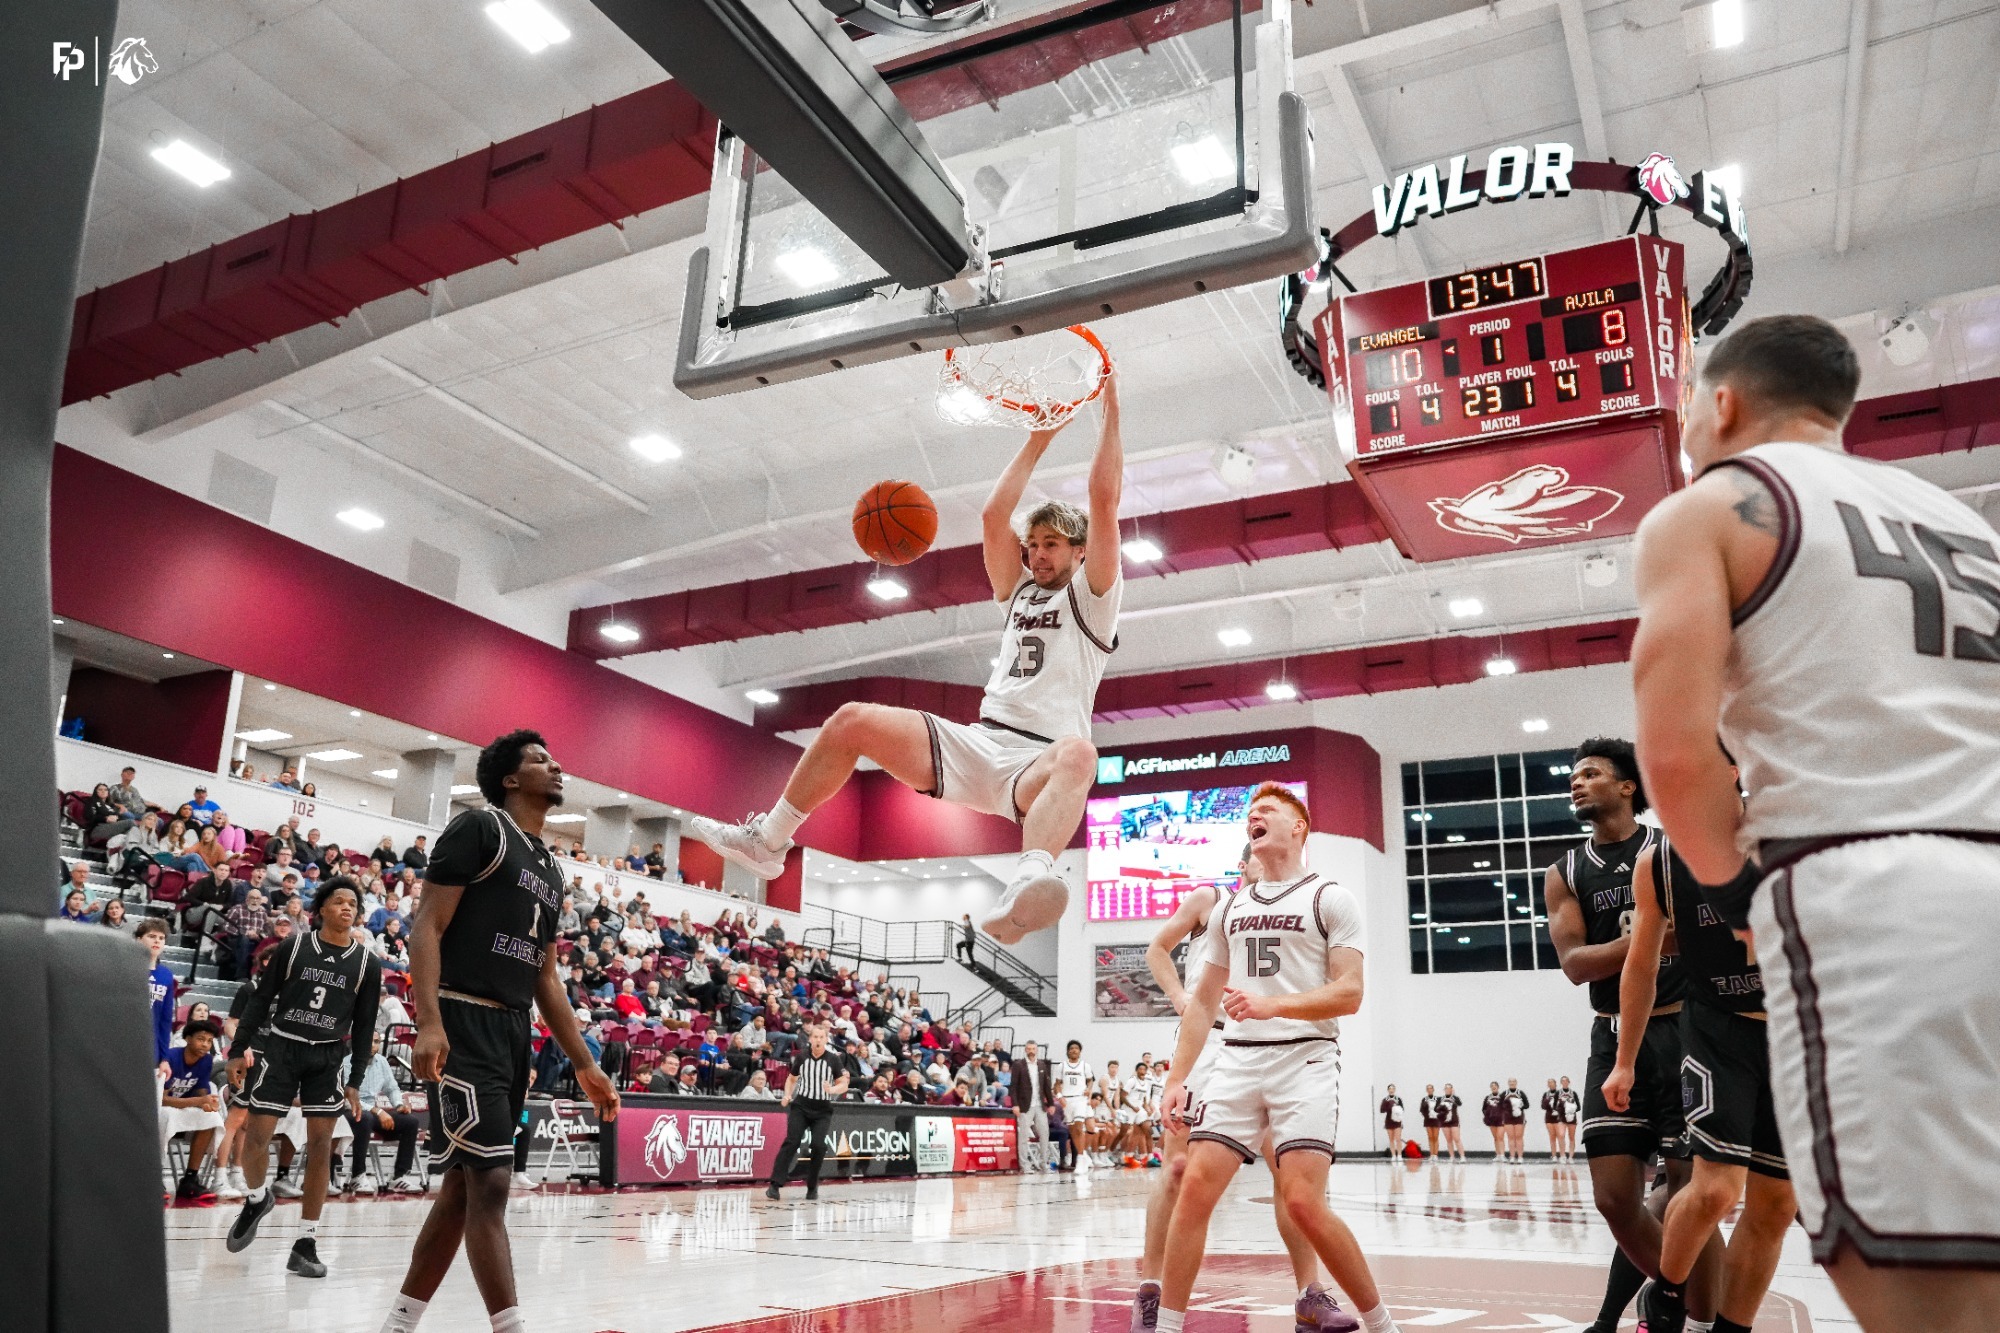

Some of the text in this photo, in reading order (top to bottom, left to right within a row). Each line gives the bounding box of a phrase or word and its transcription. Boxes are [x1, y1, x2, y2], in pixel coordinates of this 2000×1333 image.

[1372, 142, 1574, 234] VALOR
[1446, 261, 1540, 309] 13:47
[1565, 288, 1615, 312] AVILA
[1653, 244, 1676, 379] VALOR
[1470, 318, 1511, 335] PERIOD
[1602, 309, 1626, 346] 8
[1360, 327, 1426, 351] EVANGEL
[1494, 337, 1503, 361] 1
[1321, 310, 1346, 412] VALO
[1390, 347, 1423, 383] 10
[1549, 358, 1580, 373] T.O.L.
[1595, 347, 1634, 364] FOULS
[1459, 364, 1536, 389] PLAYER FOUL
[1557, 373, 1577, 397] 4
[1624, 364, 1632, 388] 1
[1365, 389, 1401, 406] FOULS
[1415, 382, 1444, 397] T.O.L.
[1464, 381, 1533, 417] 23 1
[1422, 397, 1440, 421] 4
[1600, 394, 1641, 412] SCORE
[1390, 405, 1398, 429] 1
[1480, 414, 1521, 432] MATCH
[1369, 434, 1406, 450] SCORE
[1834, 499, 2000, 663] 45
[1124, 744, 1291, 777] AGFinancial ARENA
[292, 800, 315, 818] 102
[517, 868, 559, 912] AVILA
[1593, 884, 1636, 913] AVI
[1229, 915, 1307, 937] EVANGEL
[1245, 937, 1281, 978] 15
[300, 967, 347, 989] AVILA
[309, 986, 327, 1010] 3
[284, 1008, 337, 1030] EAGLES
[689, 1119, 762, 1147] EVANGEL
[699, 1147, 752, 1174] VALOR
